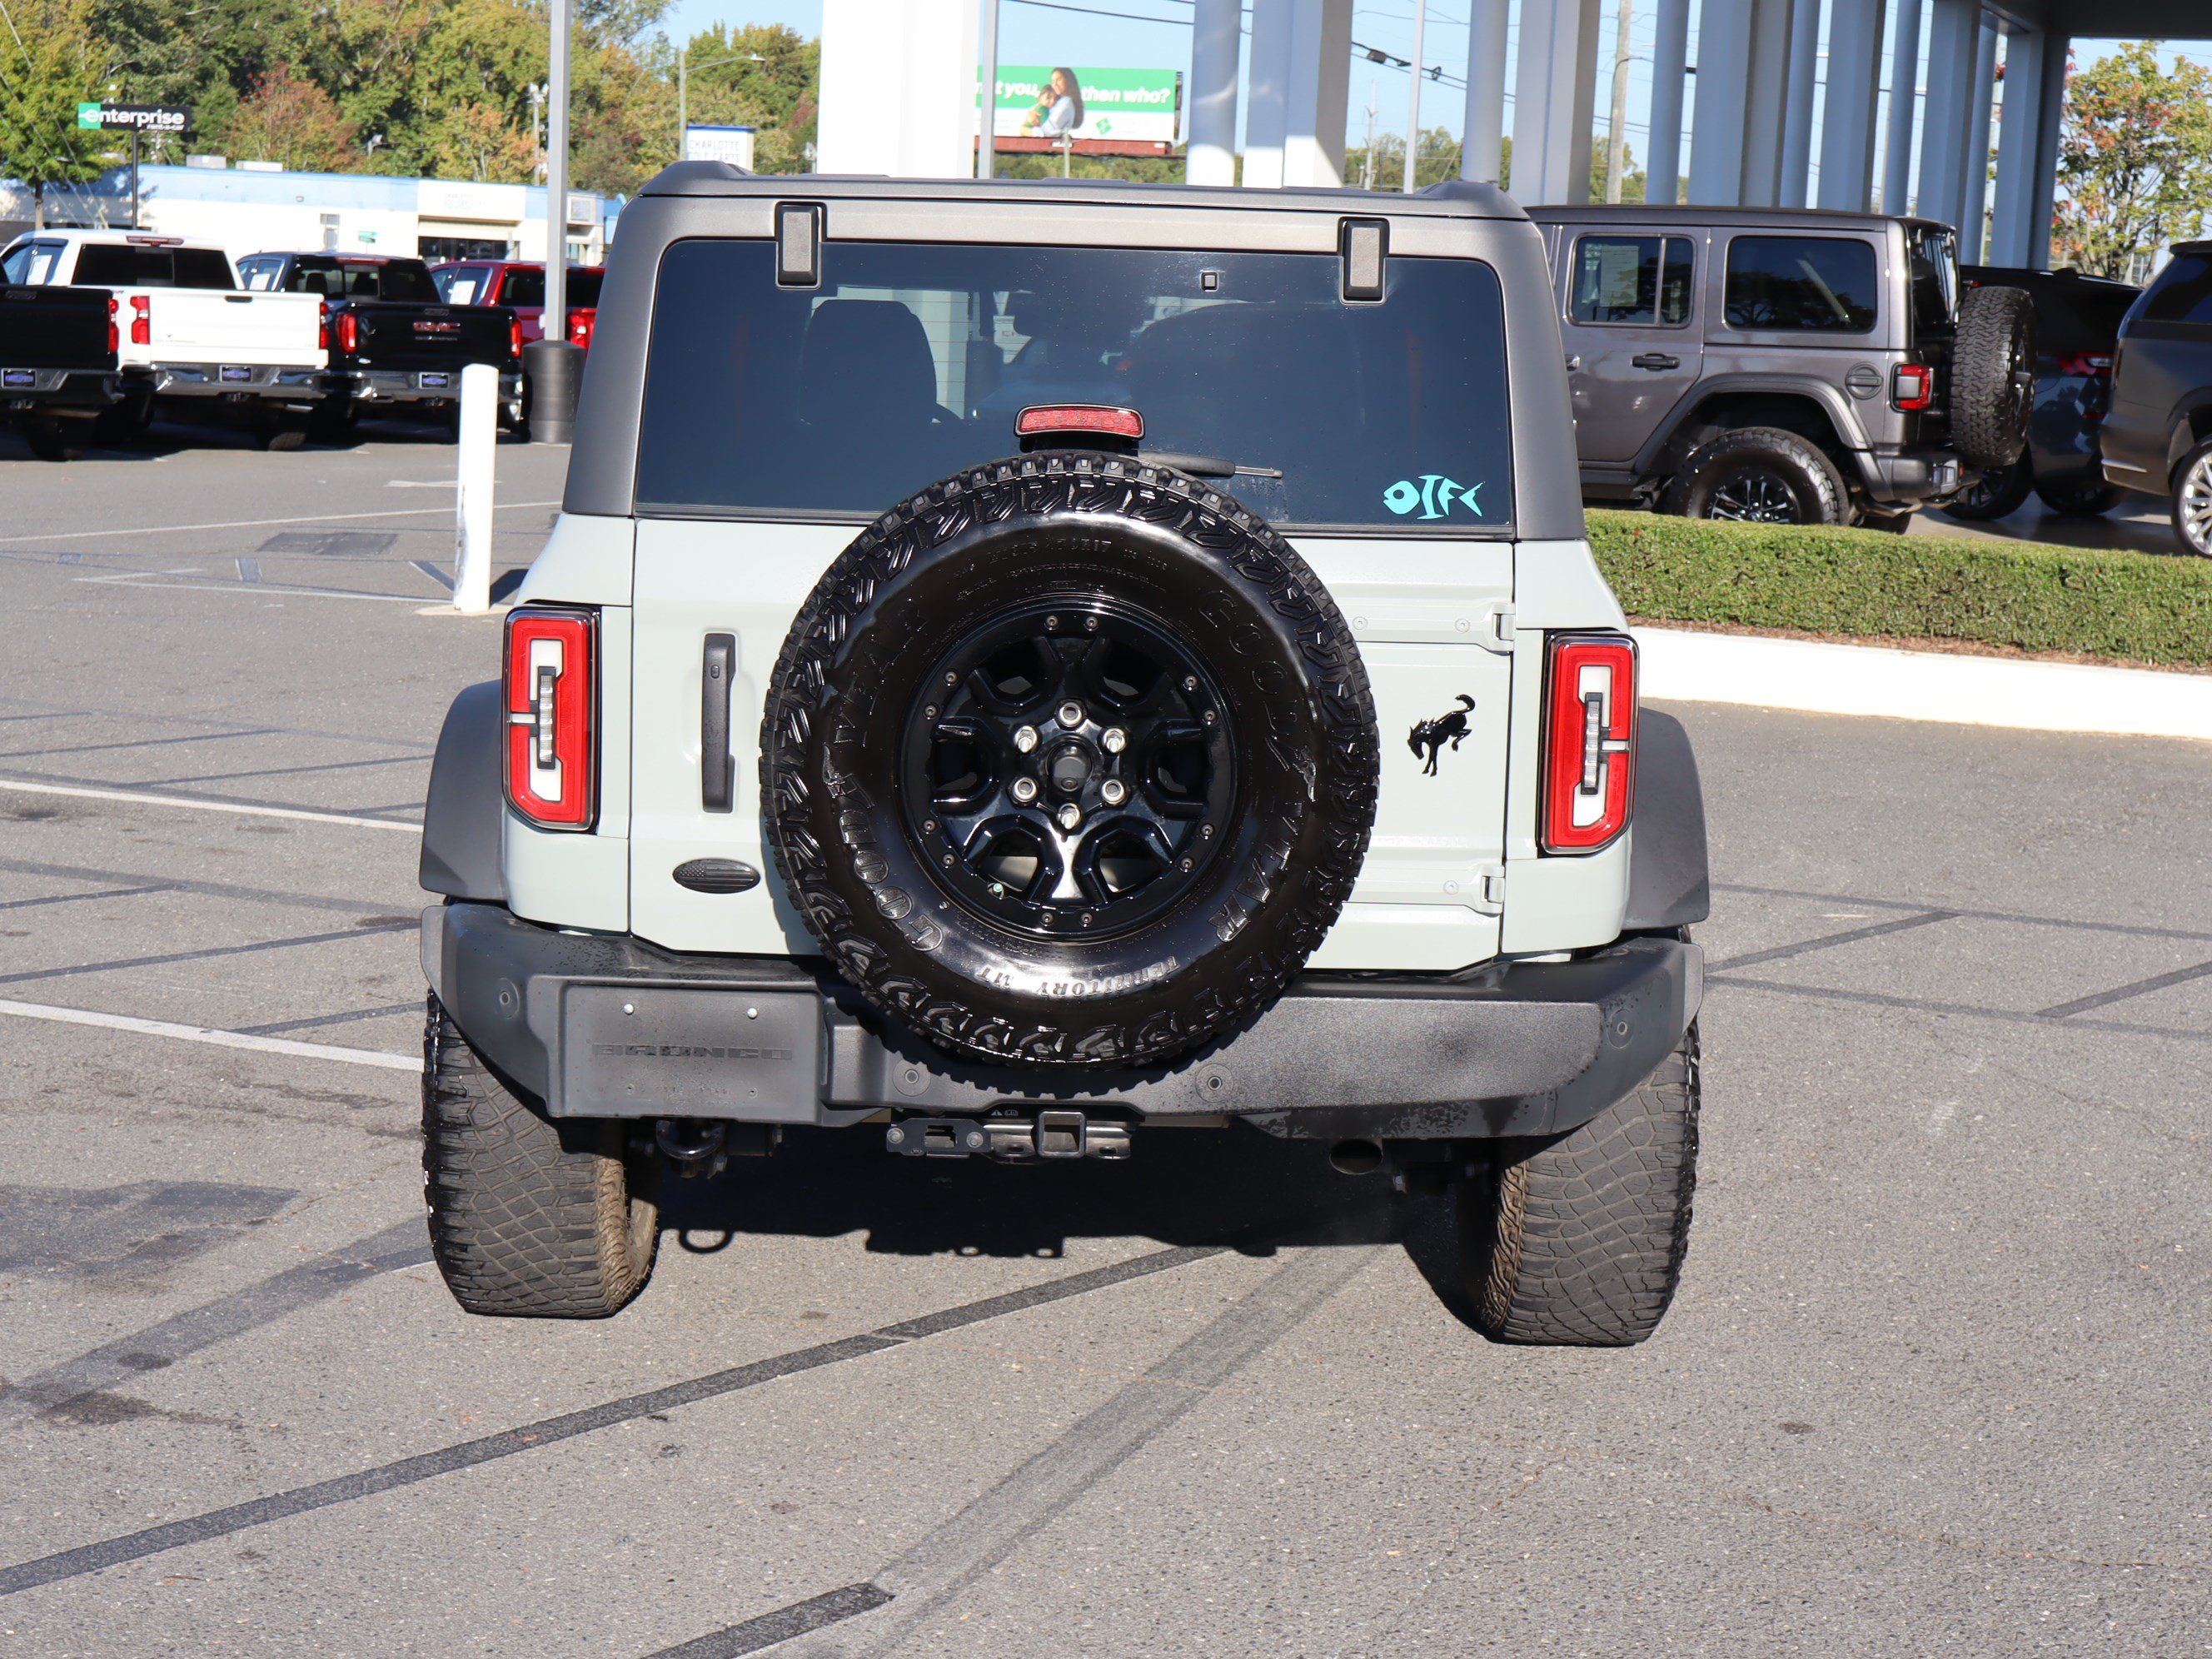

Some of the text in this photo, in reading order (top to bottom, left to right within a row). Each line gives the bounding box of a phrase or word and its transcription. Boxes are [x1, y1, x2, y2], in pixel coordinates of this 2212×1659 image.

[1004, 82, 1040, 99] you,
[1082, 86, 1121, 102] then
[1123, 87, 1170, 103] who?
[82, 109, 185, 127] enterprise
[689, 139, 740, 152] CHARLOTTE
[1036, 956, 1180, 997] TERRITORY
[592, 1044, 792, 1060] BRONCO
